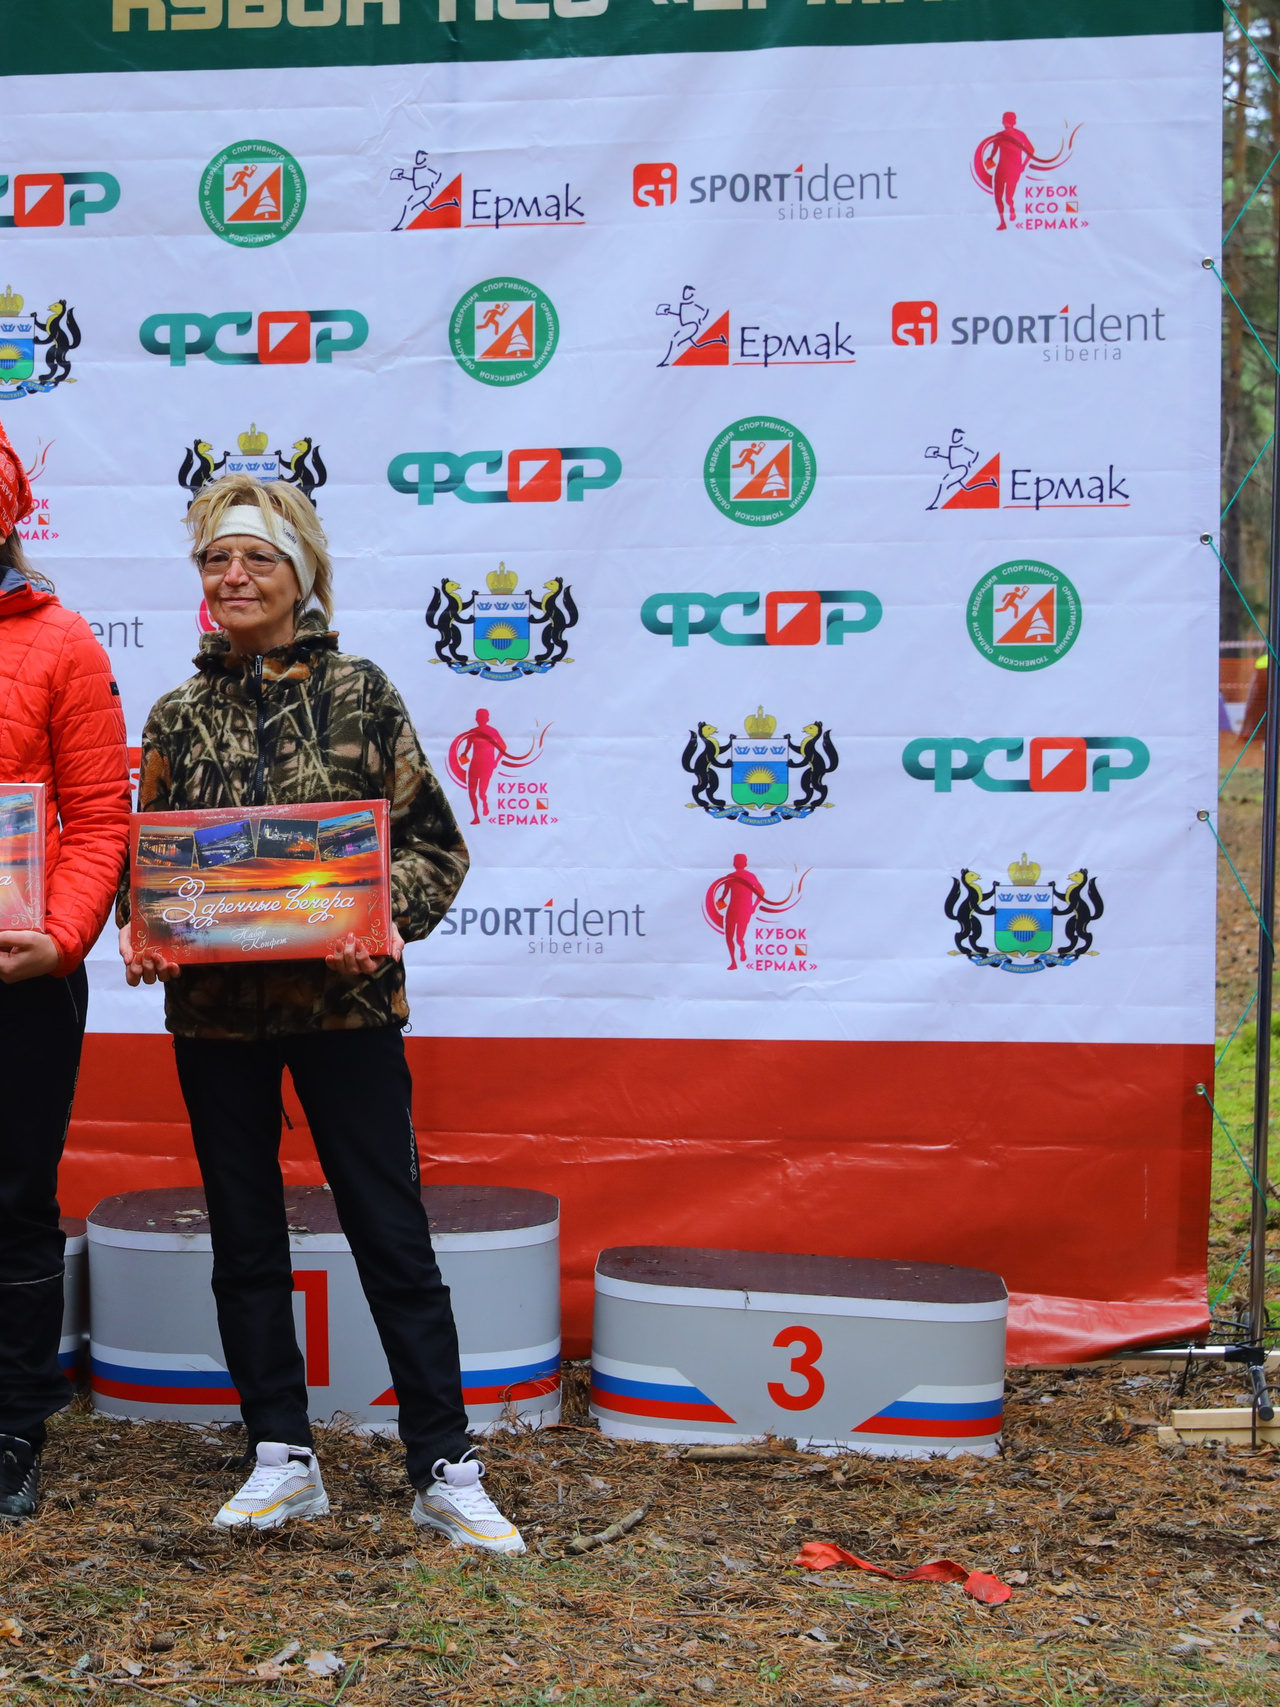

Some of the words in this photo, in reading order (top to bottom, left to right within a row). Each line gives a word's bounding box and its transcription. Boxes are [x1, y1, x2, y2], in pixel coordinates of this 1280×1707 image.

[232, 145, 285, 160] СПОРТИВНОГО
[690, 163, 898, 206] SPORTident
[1025, 185, 1078, 198] КУБОК
[471, 183, 585, 229] Ермак
[778, 203, 854, 220] siberia
[1025, 202, 1059, 214] КСО
[1015, 218, 1089, 230] «ЕРМАК»
[483, 283, 537, 298] СПОРТИВНОГО
[951, 303, 1166, 345] SPORTident
[739, 325, 856, 368] Ермак
[1043, 344, 1121, 362] siberia
[739, 421, 794, 438] СПОРТИВНОГО
[1011, 464, 1130, 510] Ермак
[1002, 565, 1059, 581] СПОРТИВНОГО
[497, 782, 548, 794] КУБОК
[498, 798, 530, 810] КСО
[488, 814, 558, 825] «ЕРМАК»
[162, 875, 282, 929] Заречные
[230, 926, 267, 942] Набор
[755, 928, 806, 940] КУБОК
[529, 938, 603, 954] siberia
[755, 944, 788, 955] КСО
[746, 959, 818, 971] «ЕРМАК»
[291, 1270, 329, 1386] 1
[767, 1325, 825, 1411] 3
